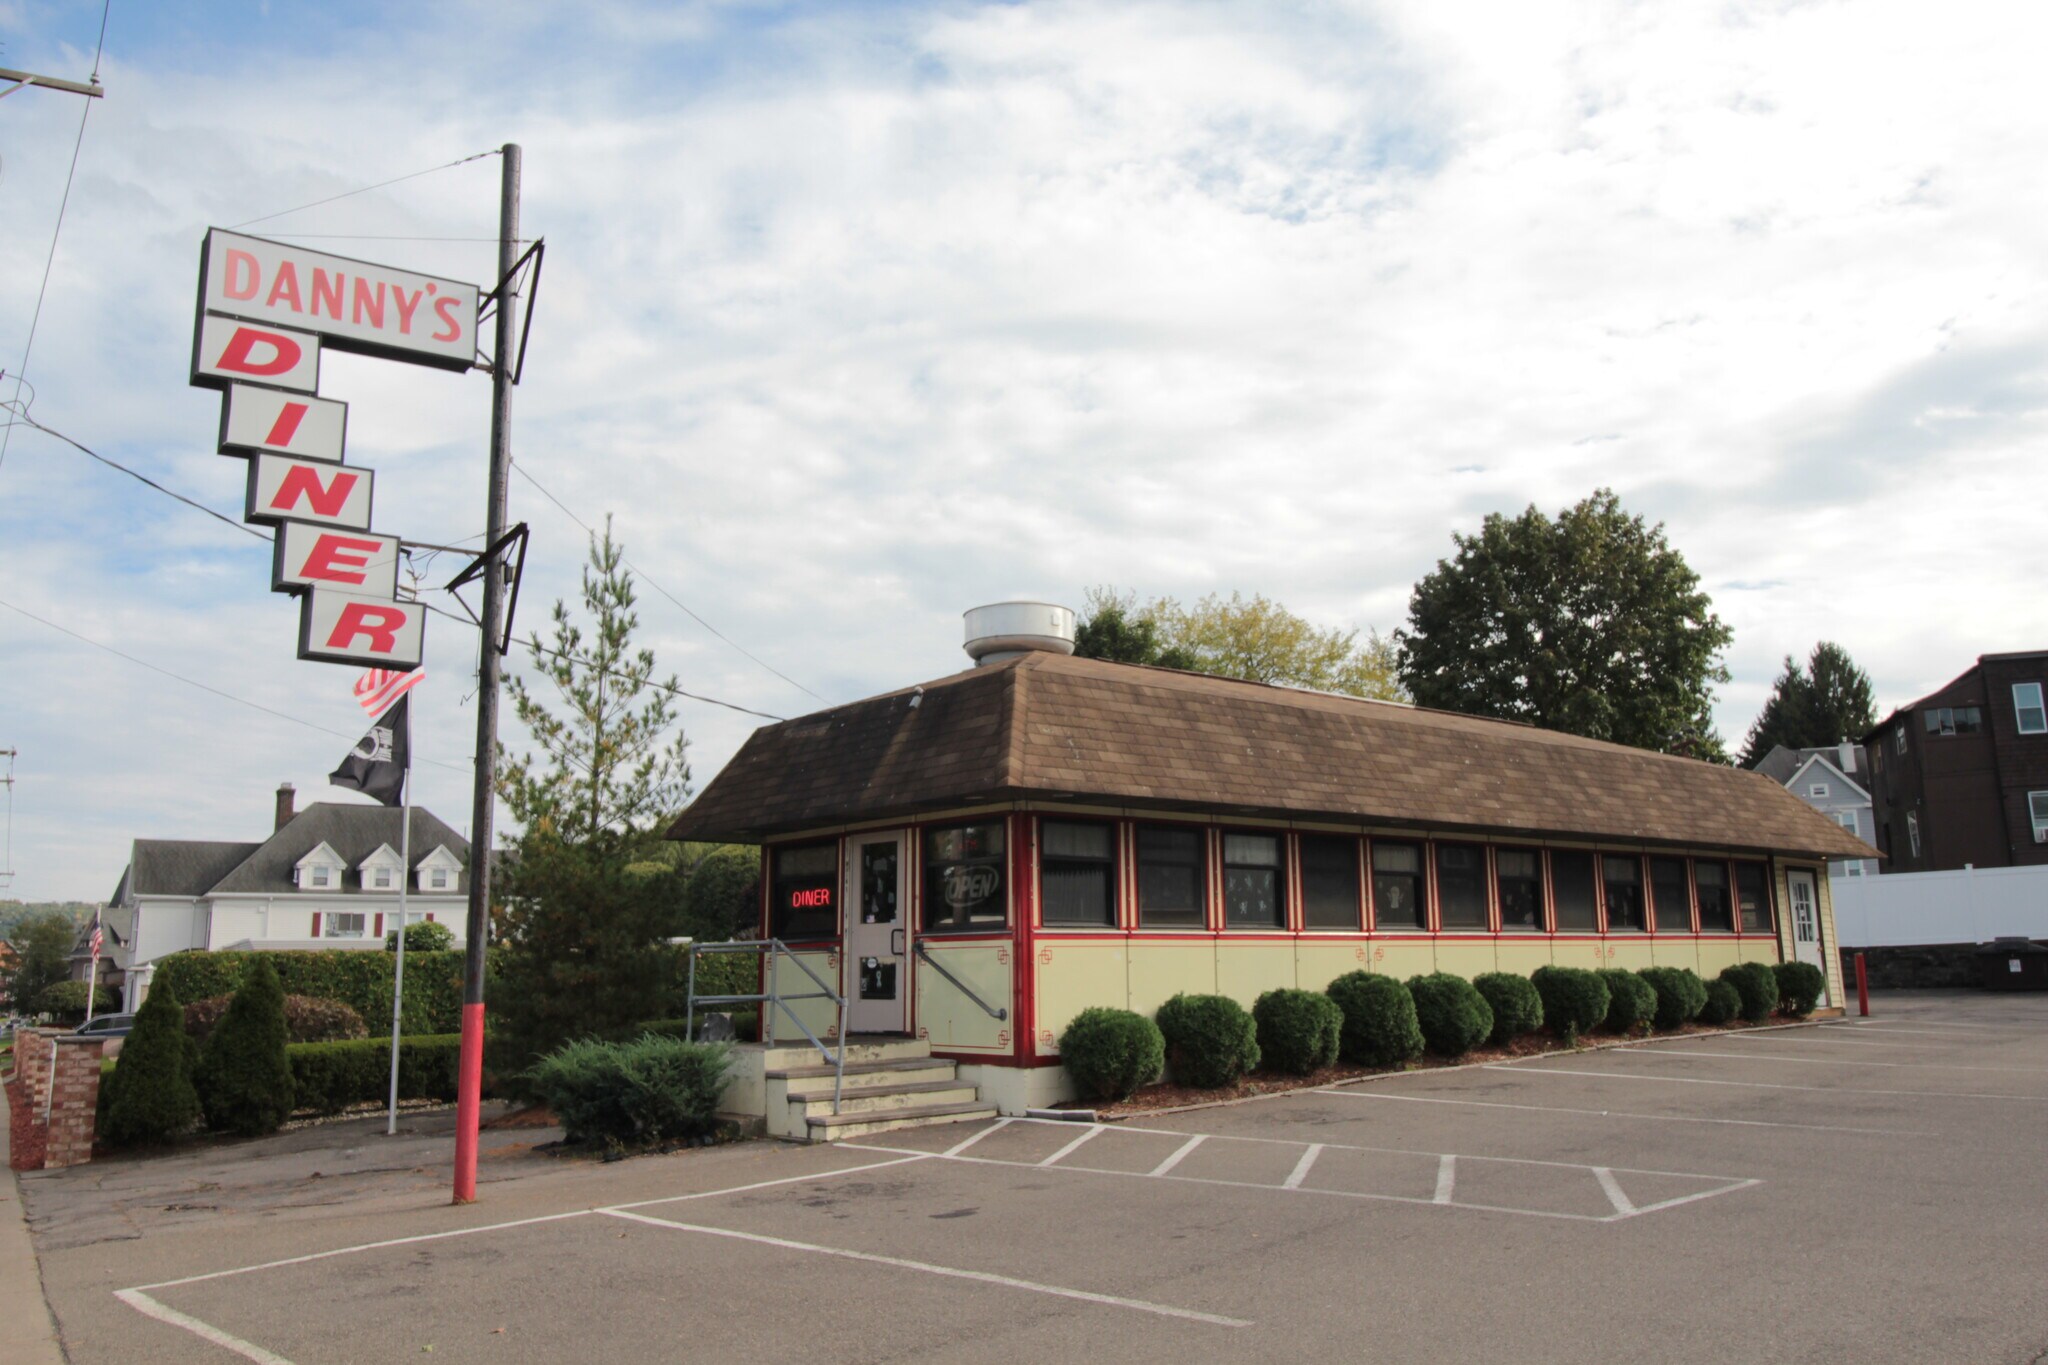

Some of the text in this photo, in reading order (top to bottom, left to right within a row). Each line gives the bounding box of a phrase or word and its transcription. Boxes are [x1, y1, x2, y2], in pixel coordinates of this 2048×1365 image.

[223, 248, 462, 342] DANNY'S
[215, 326, 407, 654] DINER
[792, 888, 830, 908] DINER
[948, 872, 993, 900] OPEN
